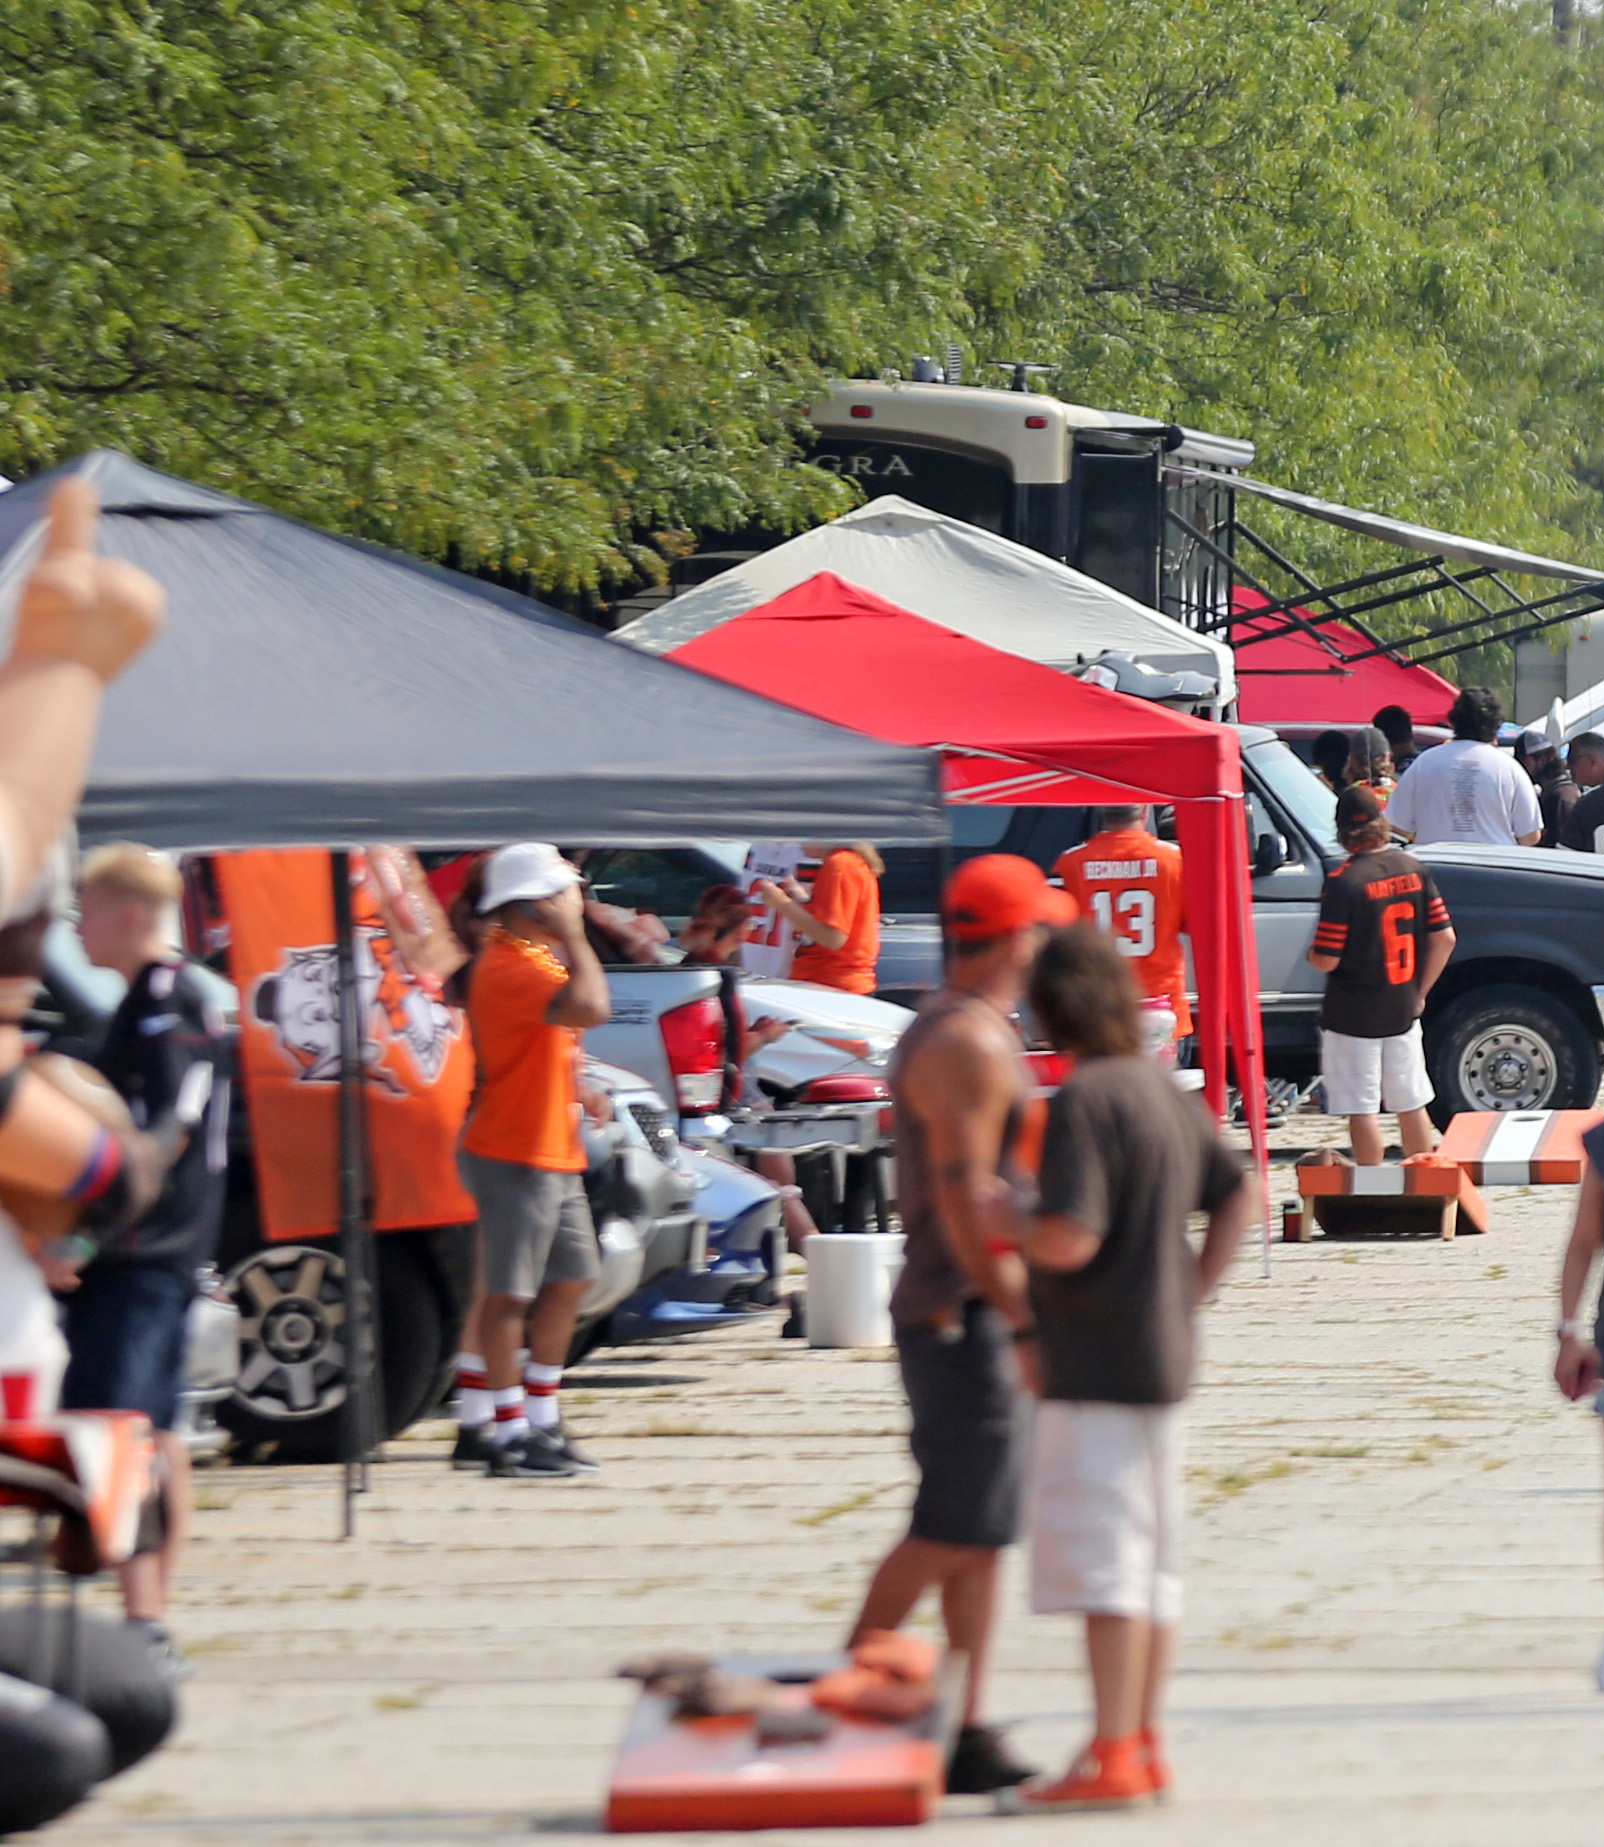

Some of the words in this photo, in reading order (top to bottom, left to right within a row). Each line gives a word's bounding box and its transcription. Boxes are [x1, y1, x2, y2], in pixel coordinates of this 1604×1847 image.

[784, 454, 914, 477] GRA
[1083, 860, 1142, 881] BECKHAM
[1143, 858, 1158, 878] JR
[1363, 872, 1425, 901] MAYFIELD
[1090, 888, 1157, 958] 13
[1379, 900, 1418, 986] 6
